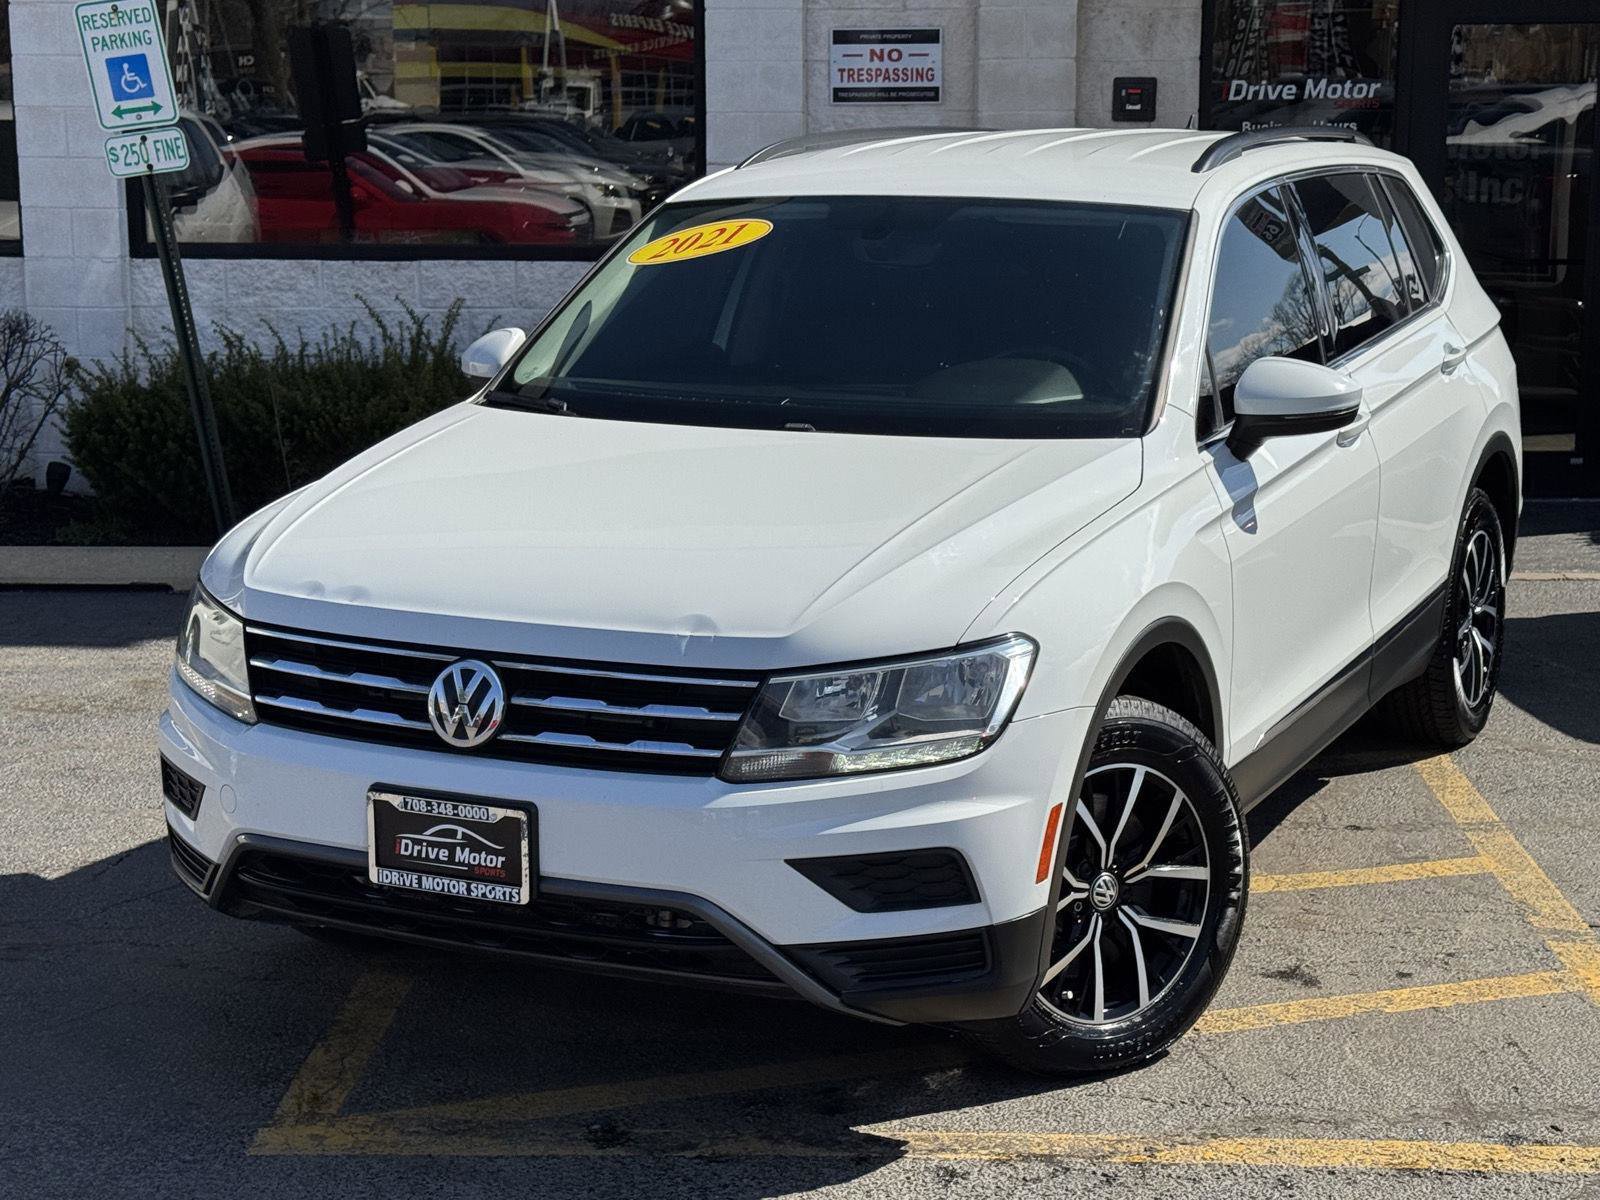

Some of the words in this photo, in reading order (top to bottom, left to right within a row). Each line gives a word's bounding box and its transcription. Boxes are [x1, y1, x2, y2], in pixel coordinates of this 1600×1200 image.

[81, 7, 152, 31] RESERVED
[91, 29, 152, 52] PARKING
[869, 48, 903, 62] NO
[838, 67, 935, 83] TRESPASSING
[1304, 78, 1381, 100] Motor
[109, 140, 150, 167] $250
[153, 136, 185, 163] FINE
[647, 223, 748, 260] 2021
[405, 797, 489, 821] 708-348-0000
[455, 847, 506, 869] Motor
[474, 867, 506, 879] SPORTS
[421, 875, 467, 896] MOTOR
[470, 882, 520, 903] SPORTS
